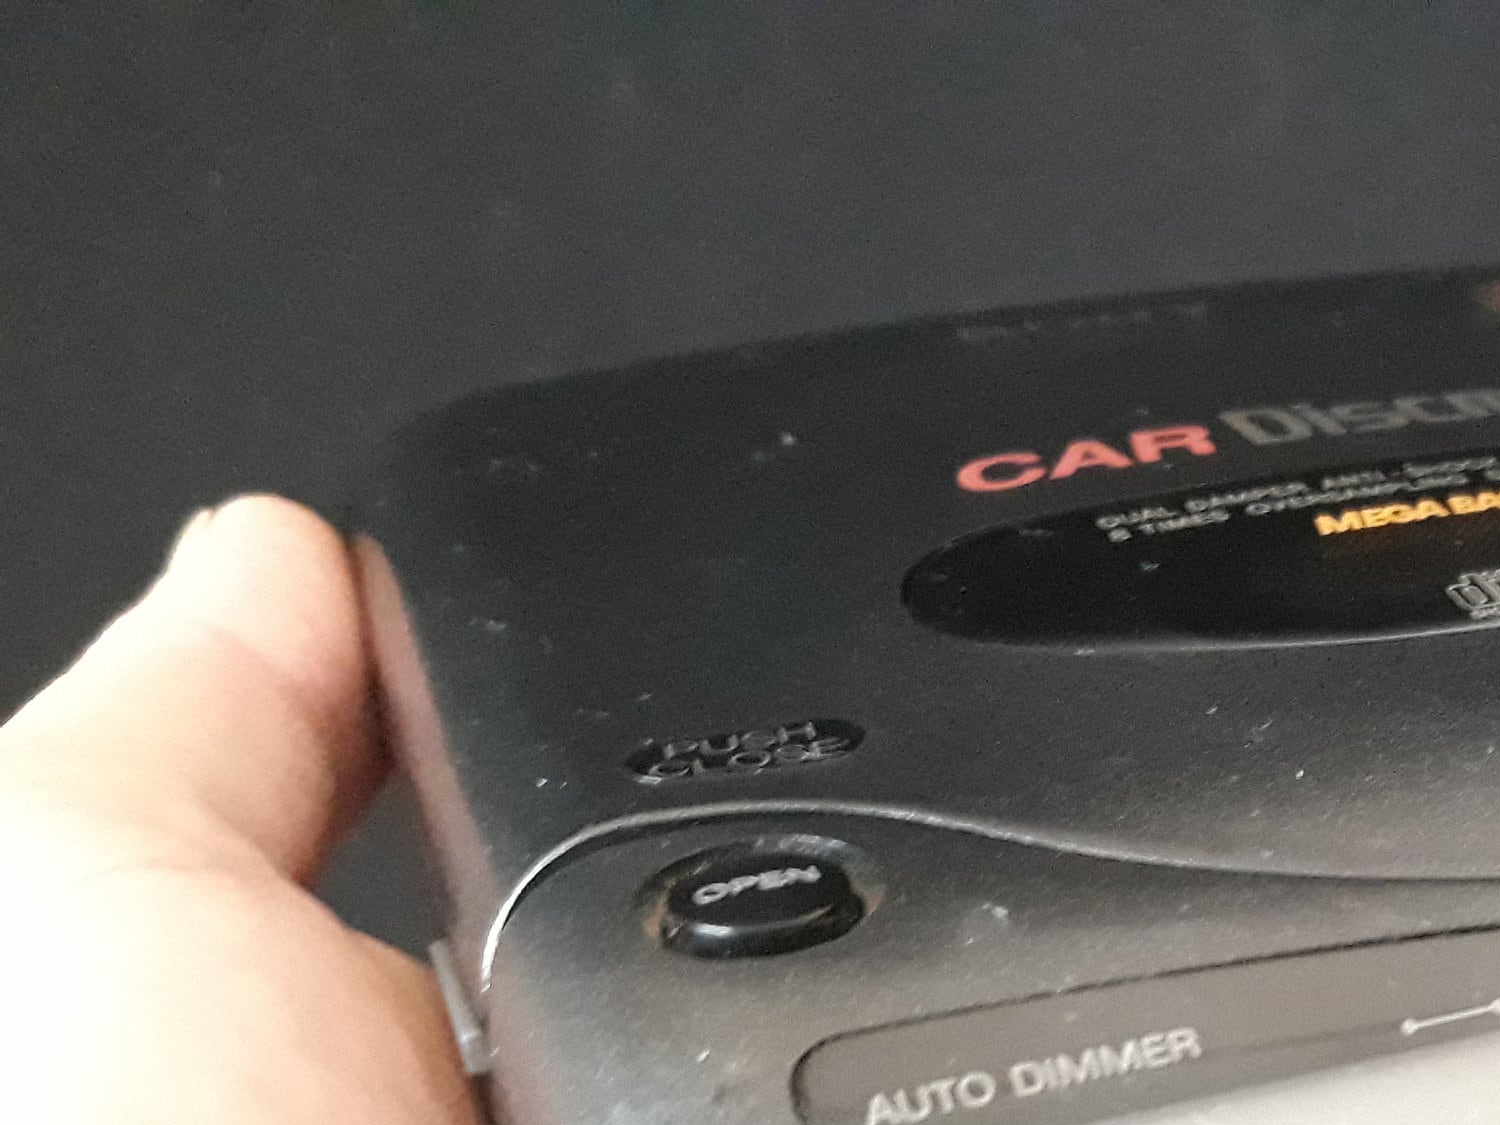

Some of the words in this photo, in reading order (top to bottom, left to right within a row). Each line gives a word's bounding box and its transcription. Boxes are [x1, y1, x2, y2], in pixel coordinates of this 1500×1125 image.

[956, 425, 1217, 493] CAR
[1313, 498, 1450, 537] MEGA
[664, 720, 818, 761] PUSH
[692, 863, 821, 905] OPEN
[1008, 1025, 1201, 1098] DIMMER
